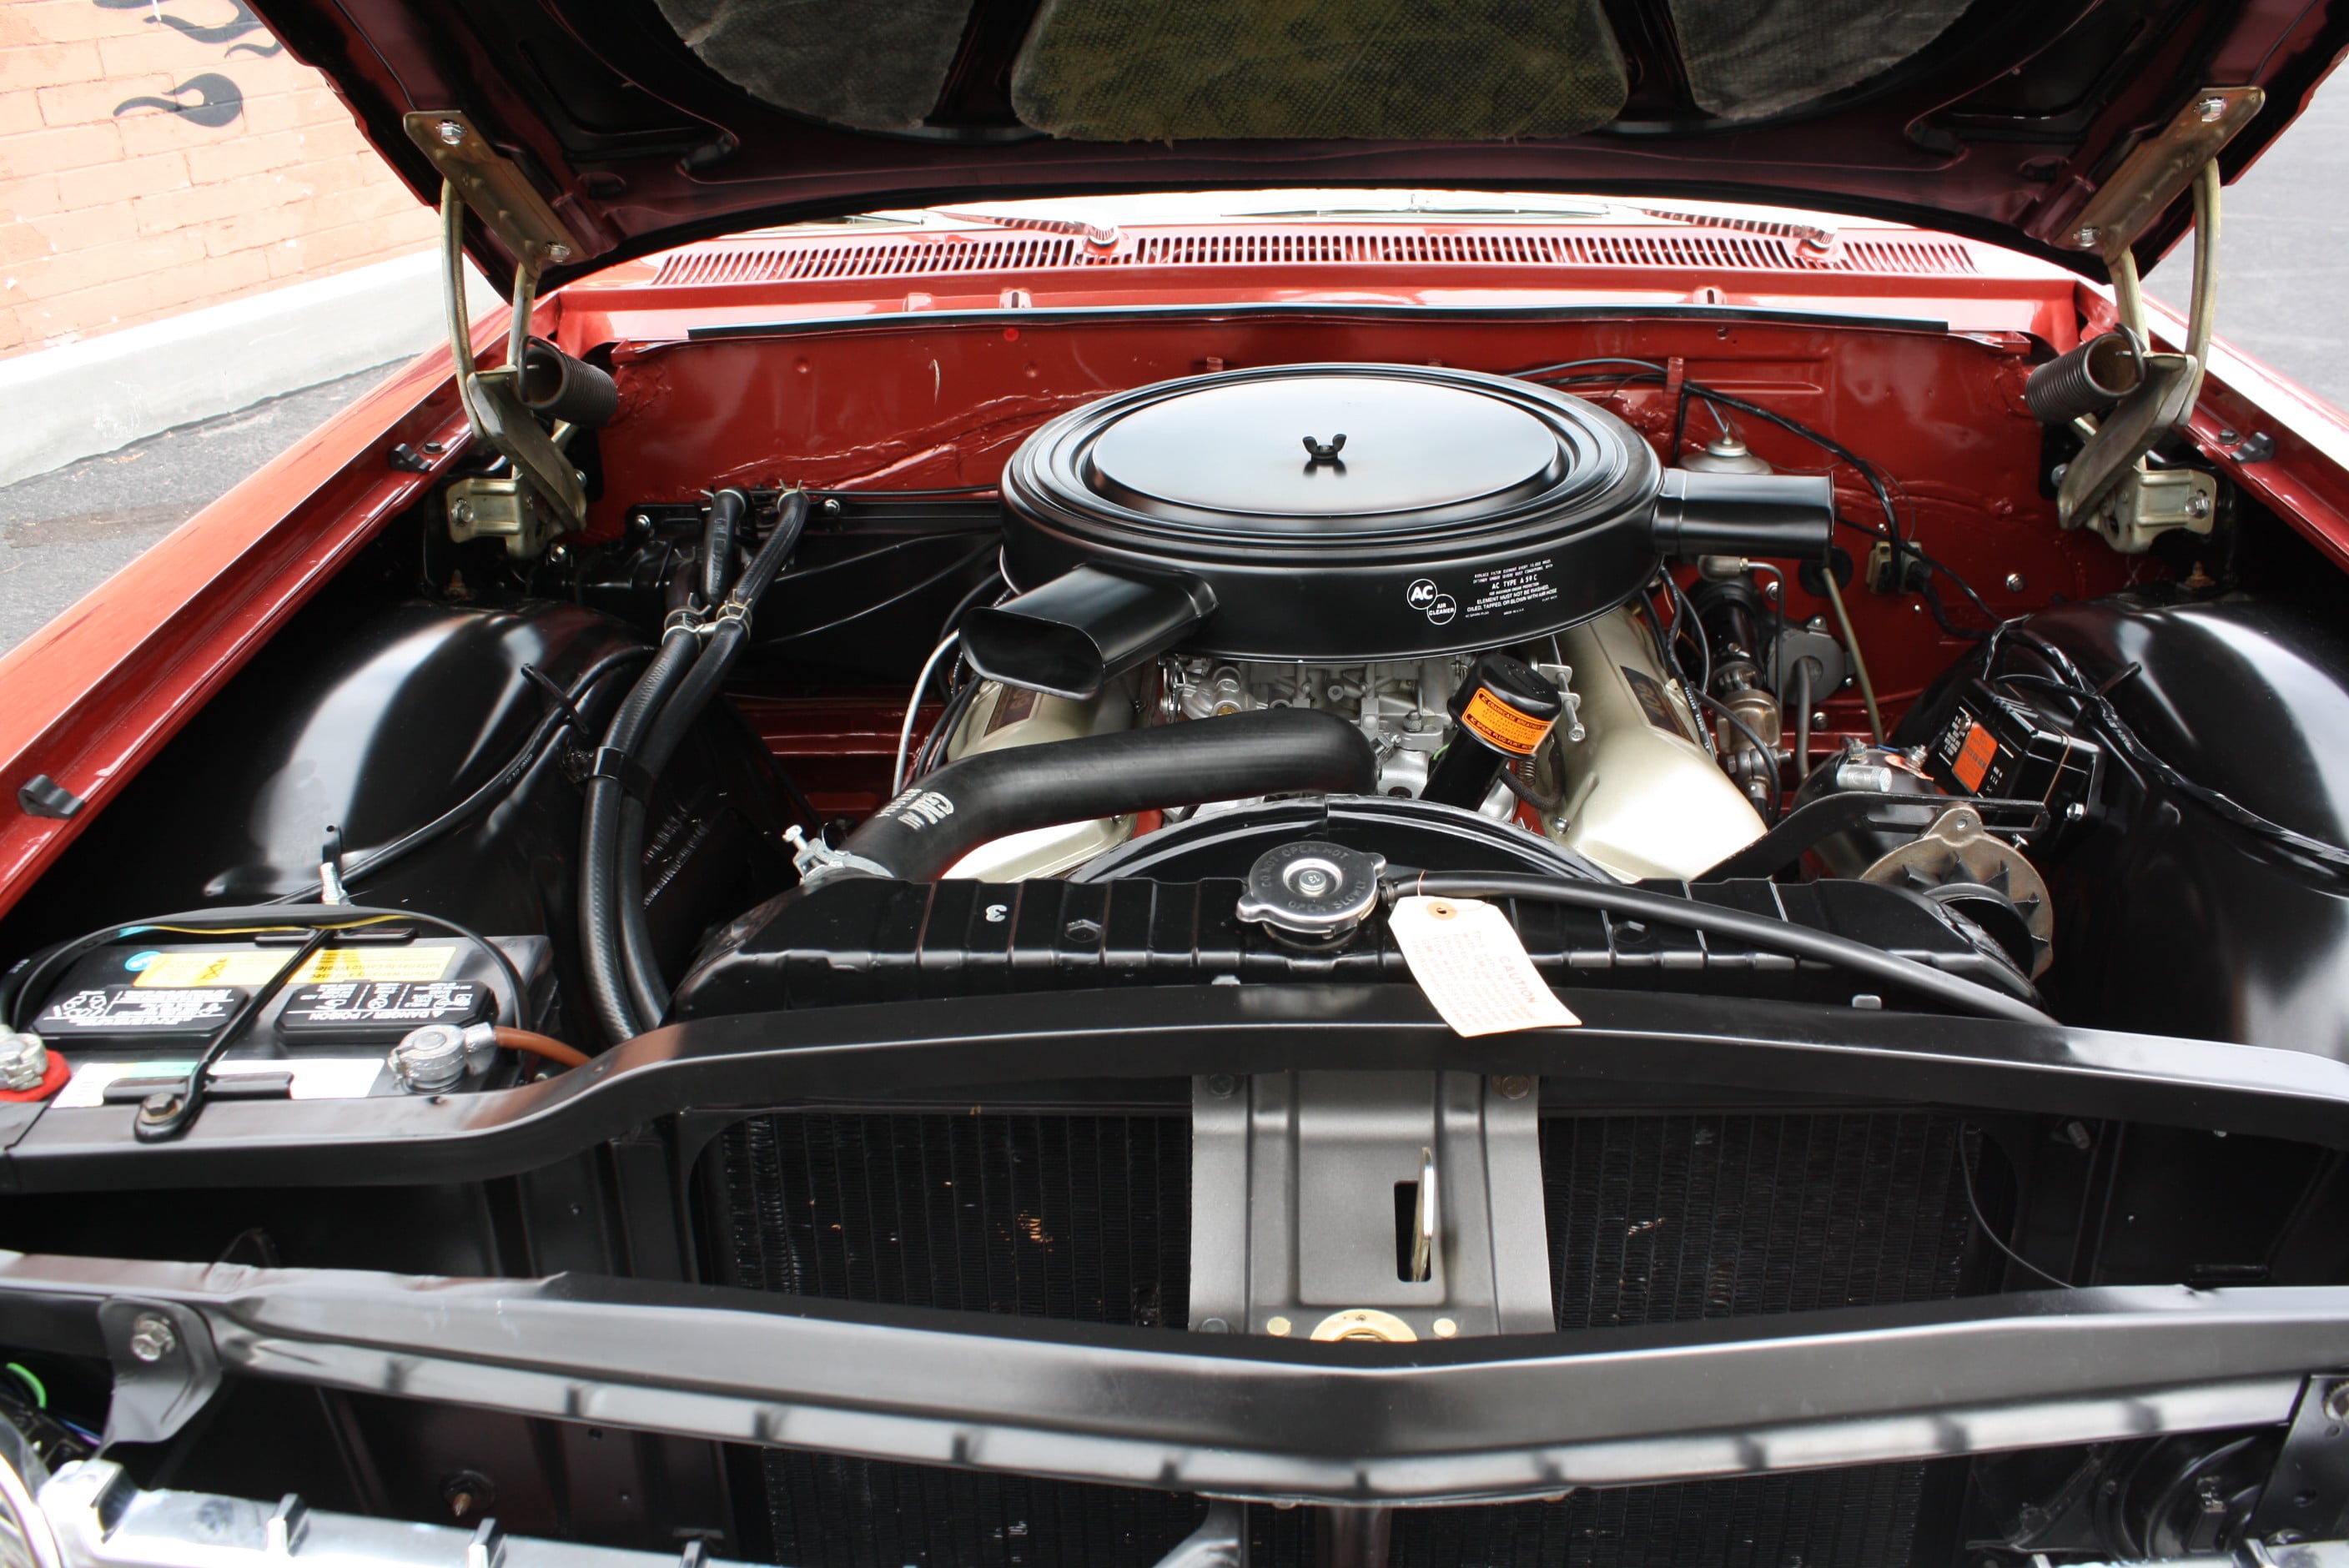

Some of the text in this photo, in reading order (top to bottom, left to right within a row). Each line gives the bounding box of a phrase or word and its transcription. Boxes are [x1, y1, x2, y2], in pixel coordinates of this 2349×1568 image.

[1504, 579, 1516, 587] TYPE
[1411, 585, 1433, 601] AC
[1477, 596, 1498, 605] ELEMENT
[1511, 596, 1527, 604] BLOWN
[1429, 608, 1454, 616] CLEANER
[1488, 701, 1516, 721] CRANKCASE
[1685, 687, 1697, 710] PACKARD
[1695, 714, 1704, 732] RADIO
[1476, 721, 1492, 734] SPARK
[907, 792, 954, 825] GM
[1281, 846, 1317, 857] OPEN
[1323, 847, 1349, 859] HOT
[1288, 901, 1326, 912] OPEN
[1500, 956, 1537, 1003] CAUTION
